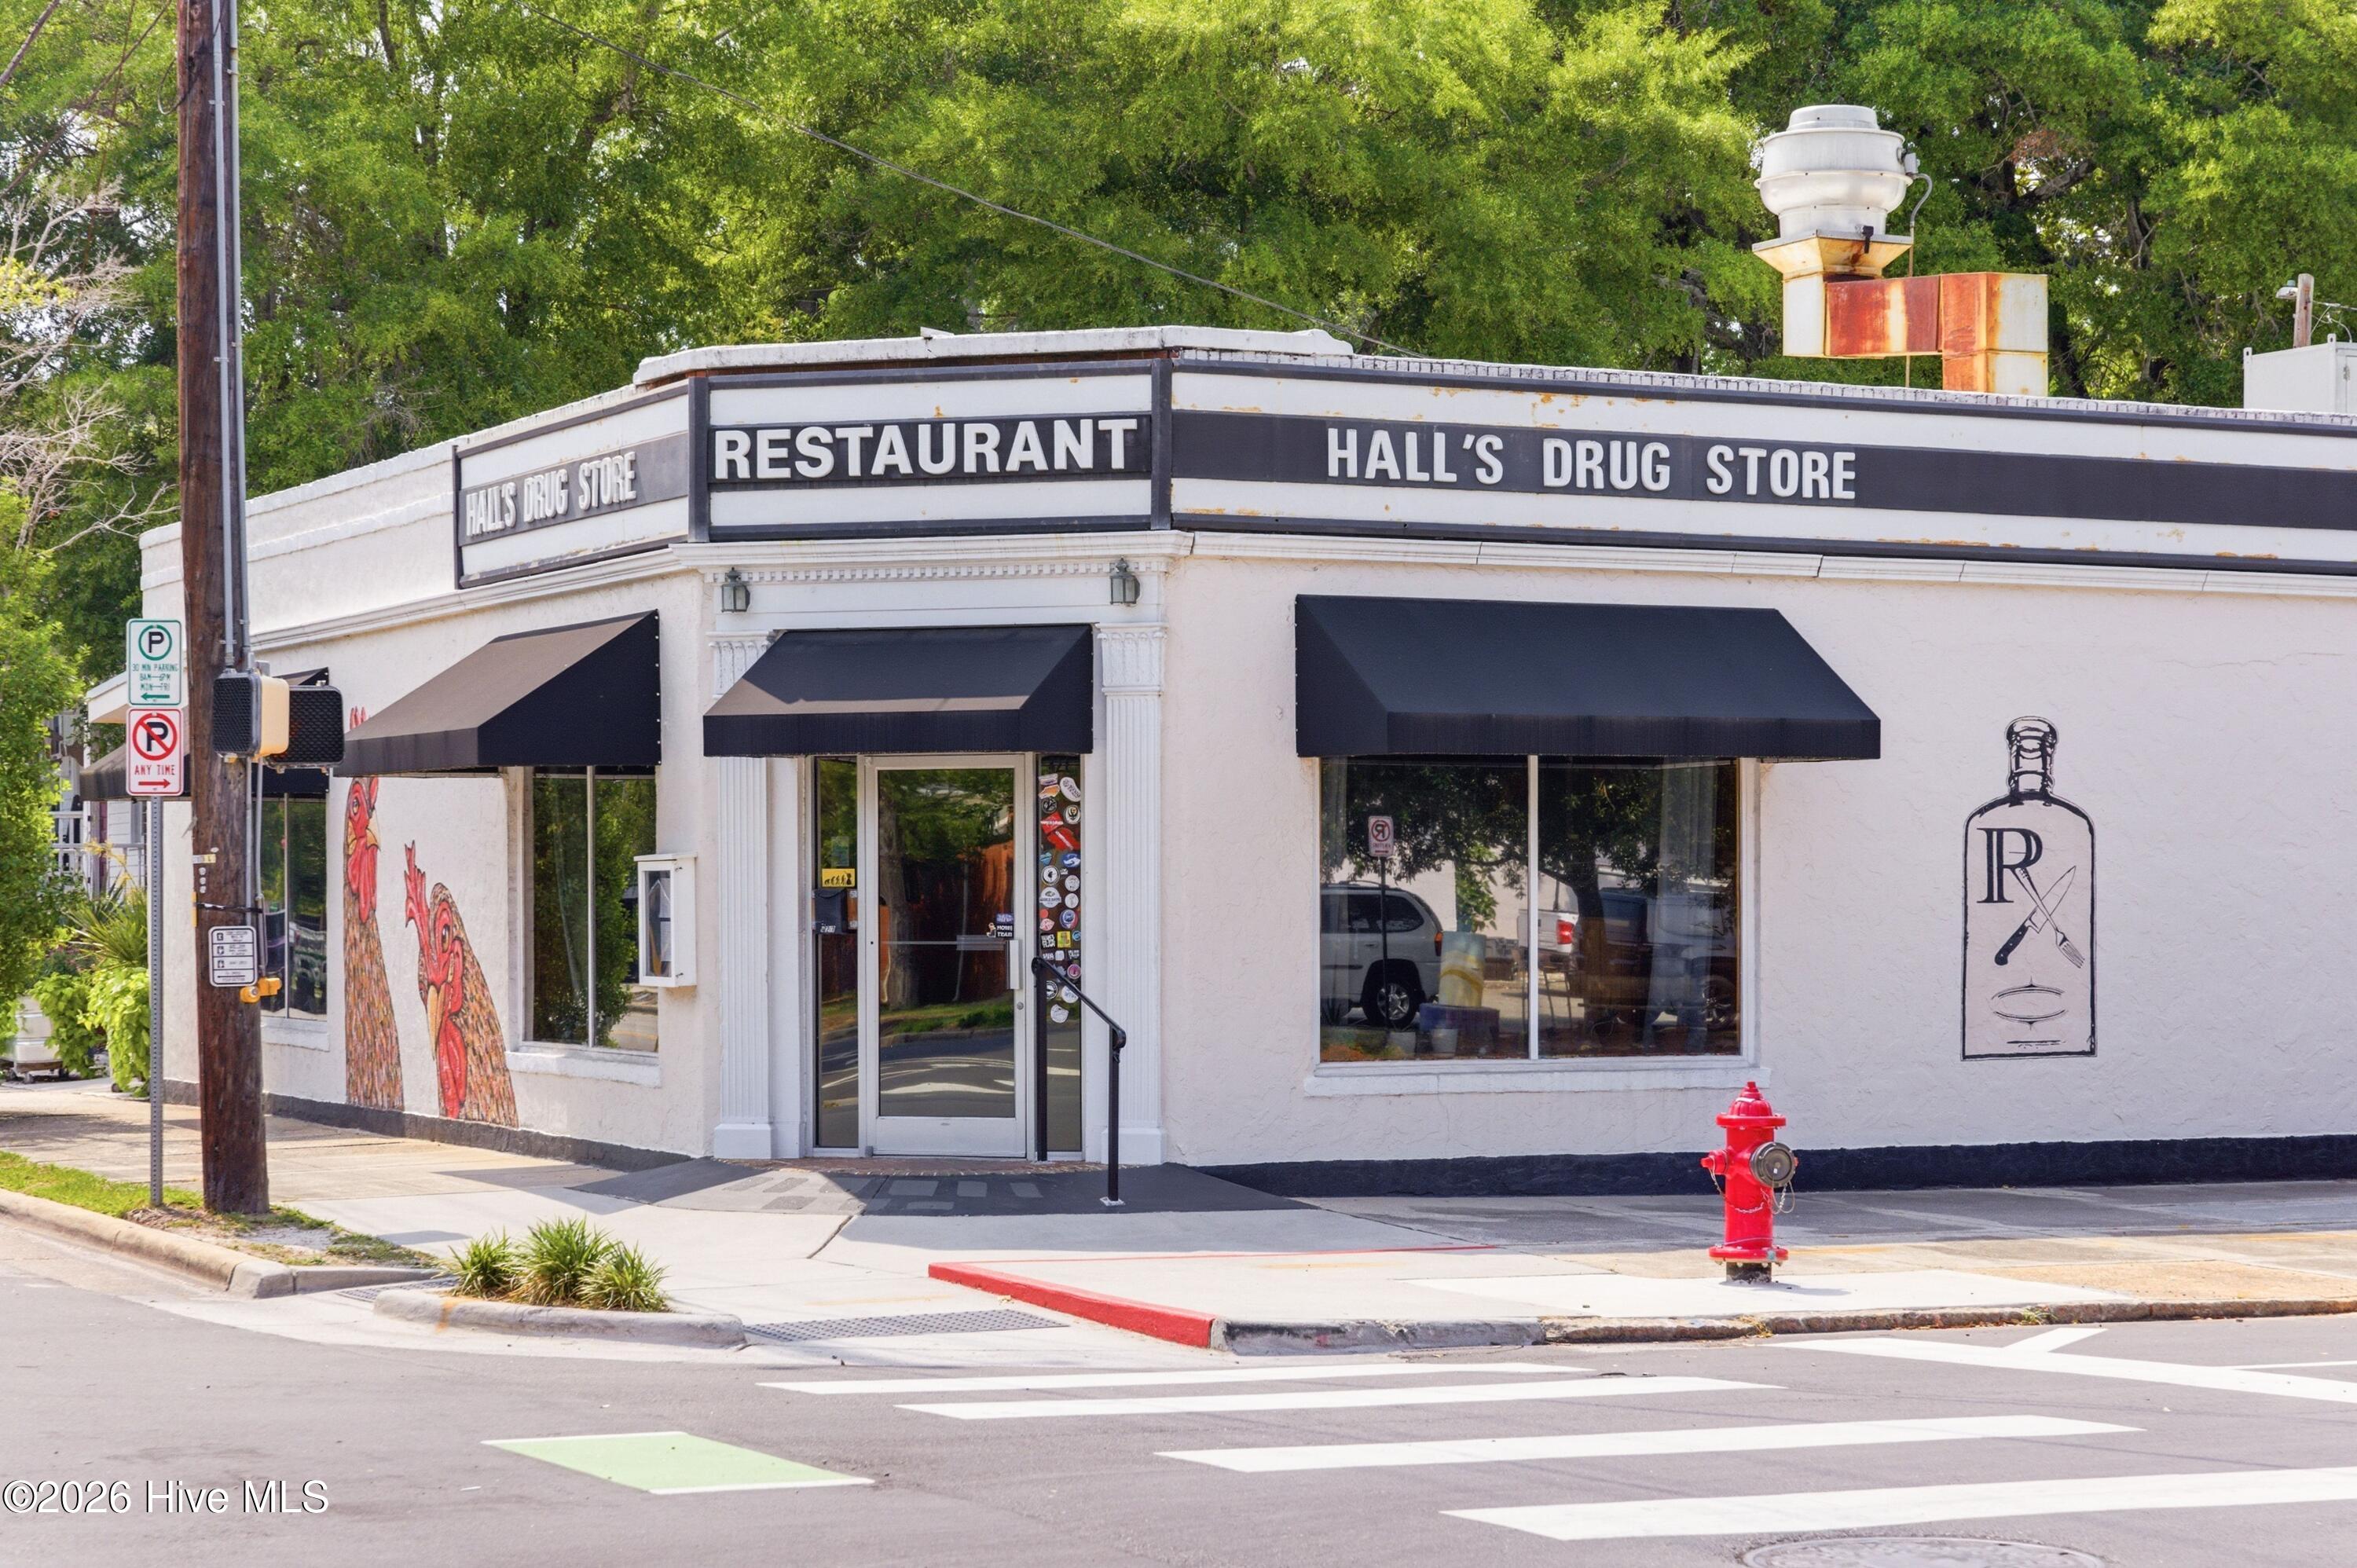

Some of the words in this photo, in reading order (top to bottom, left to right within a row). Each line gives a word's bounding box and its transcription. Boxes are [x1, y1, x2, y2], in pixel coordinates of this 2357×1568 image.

[714, 418, 1138, 479] RESTAURANT
[1327, 427, 1504, 485] HALL'S
[1542, 437, 1670, 492] DRUG
[1706, 444, 1856, 500] STORE
[466, 482, 517, 537] HALL'S
[523, 468, 569, 523] DRUG
[578, 451, 637, 511] STORE
[148, 631, 164, 653] P
[153, 663, 179, 672] PARKING
[146, 721, 169, 752] P
[134, 764, 152, 775] ANY
[157, 764, 176, 775] TIME
